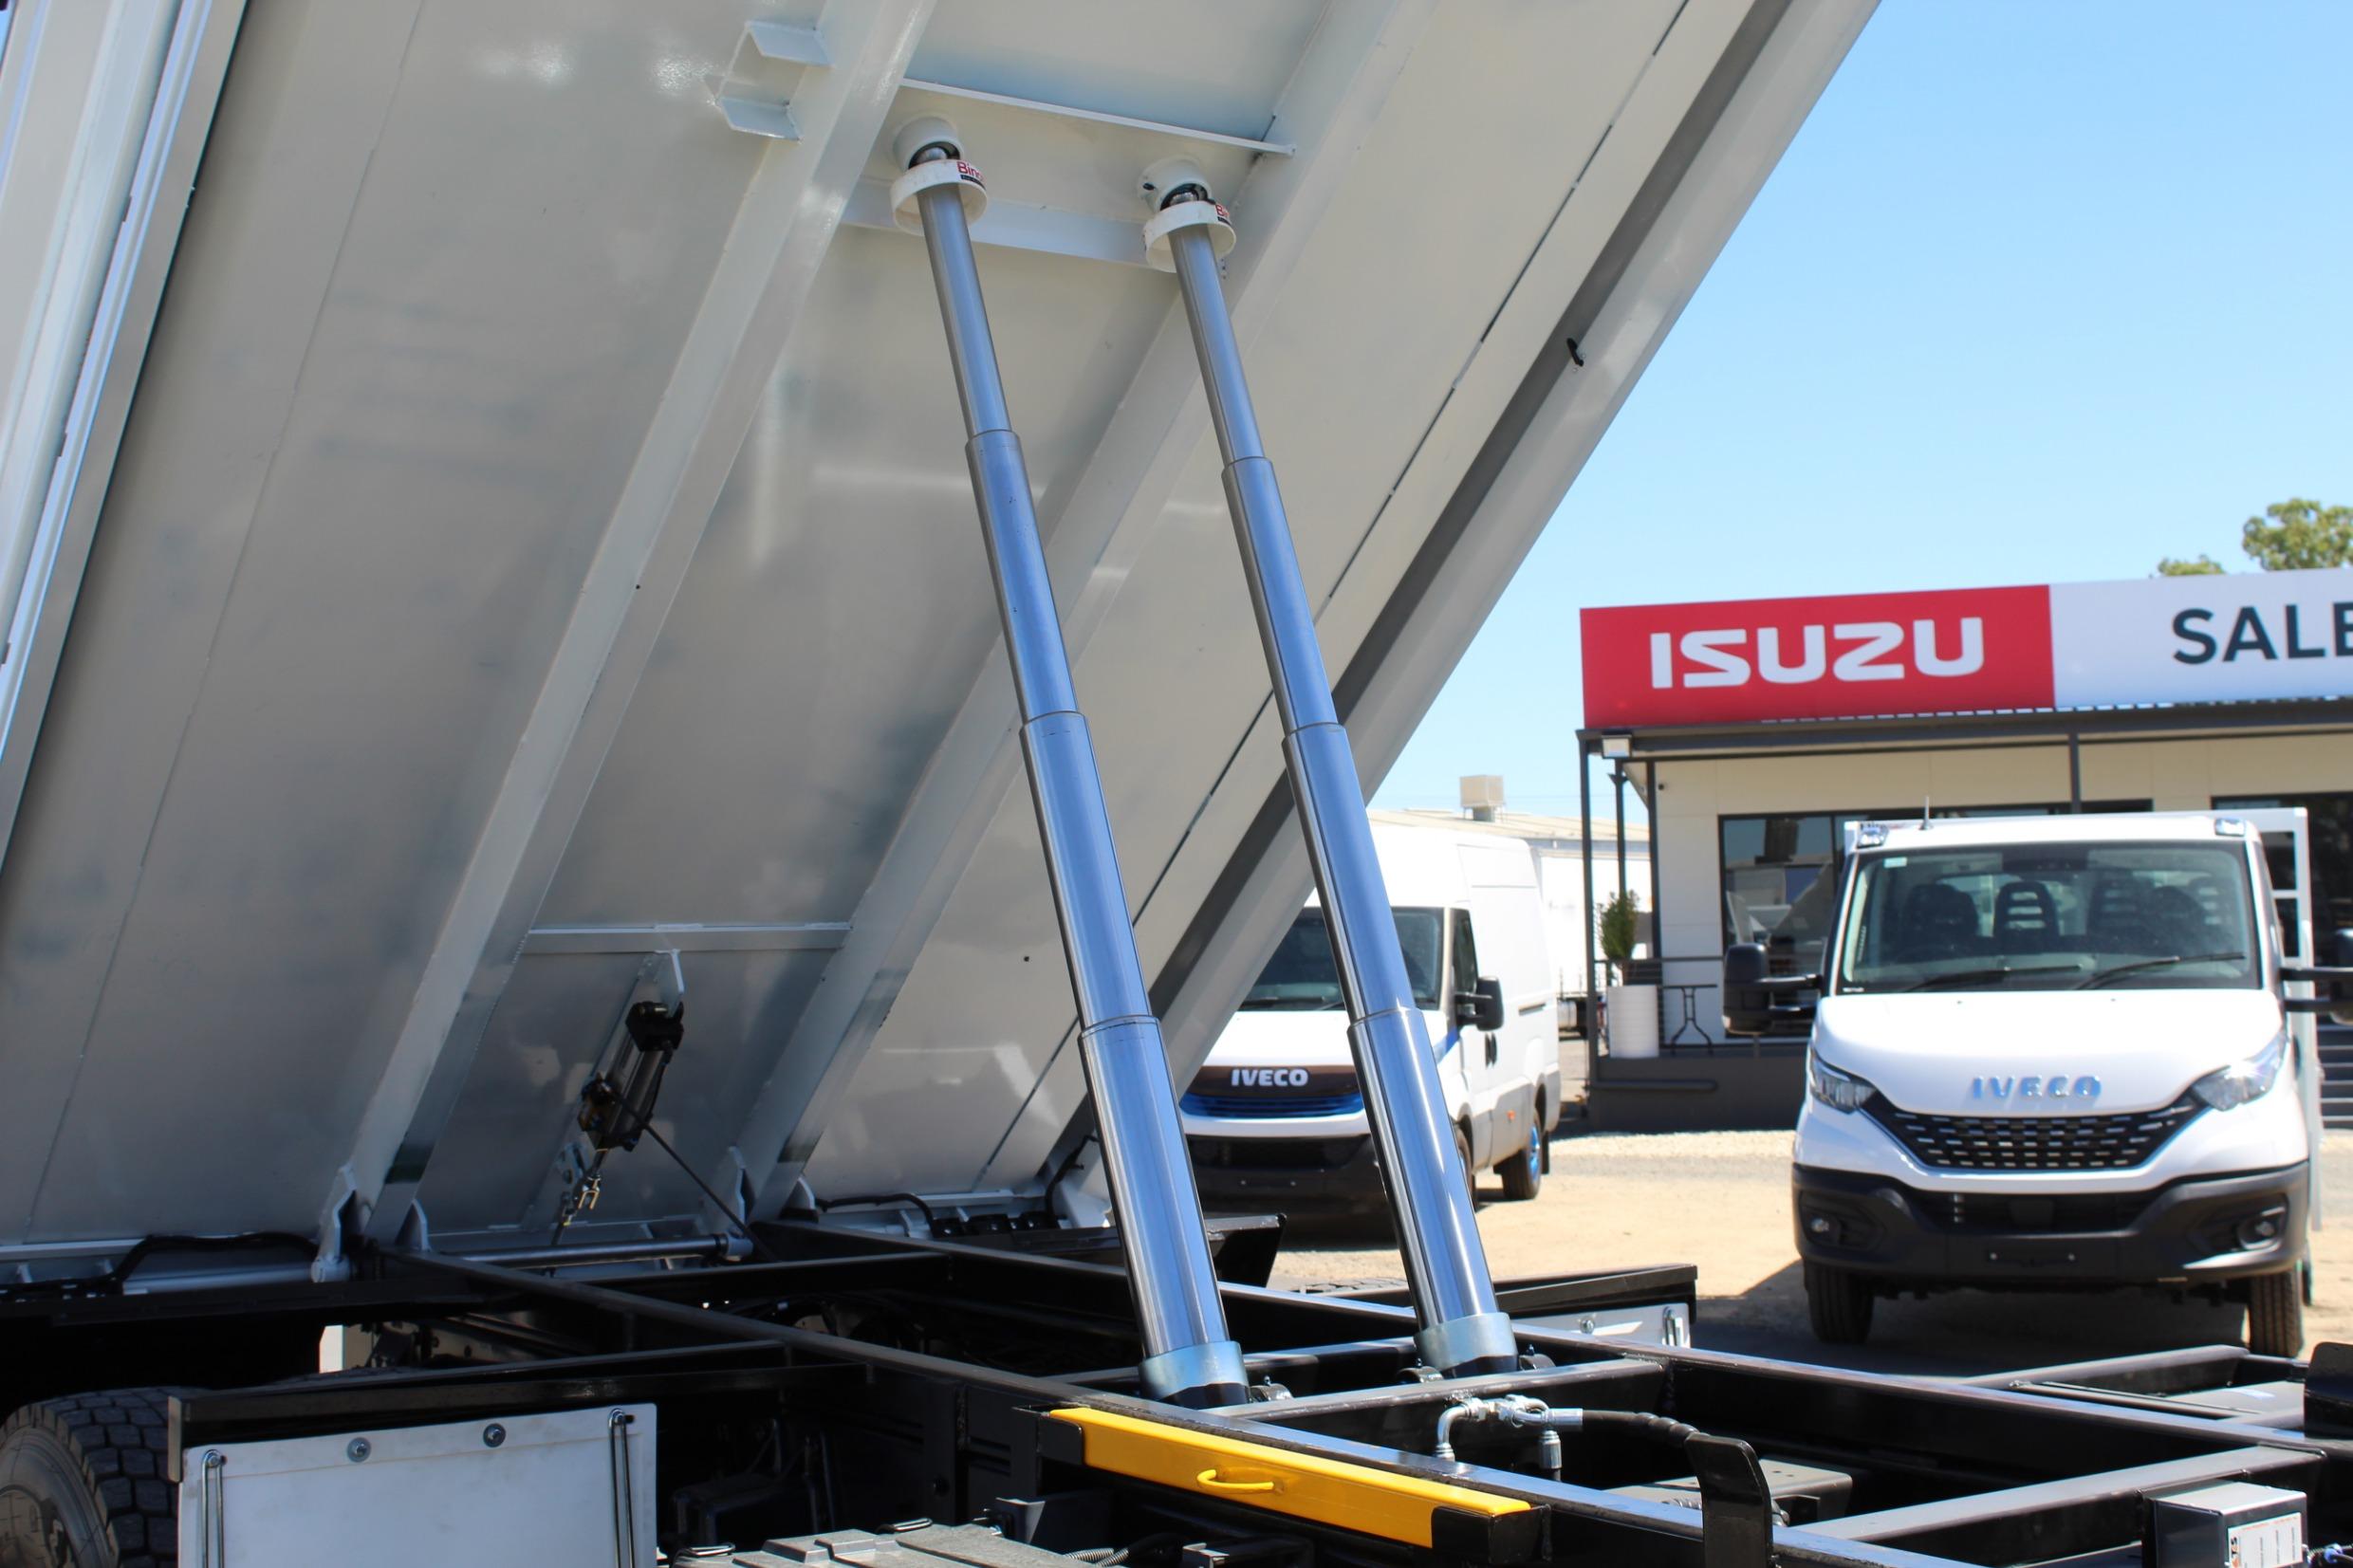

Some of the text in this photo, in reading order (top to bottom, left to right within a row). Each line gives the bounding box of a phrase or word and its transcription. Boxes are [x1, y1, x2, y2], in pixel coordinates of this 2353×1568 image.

[1650, 618, 1984, 689] ISUZU
[2172, 601, 2353, 665] SALE
[1231, 1068, 1308, 1087] IVECO
[1973, 1075, 2102, 1099] IVECO
